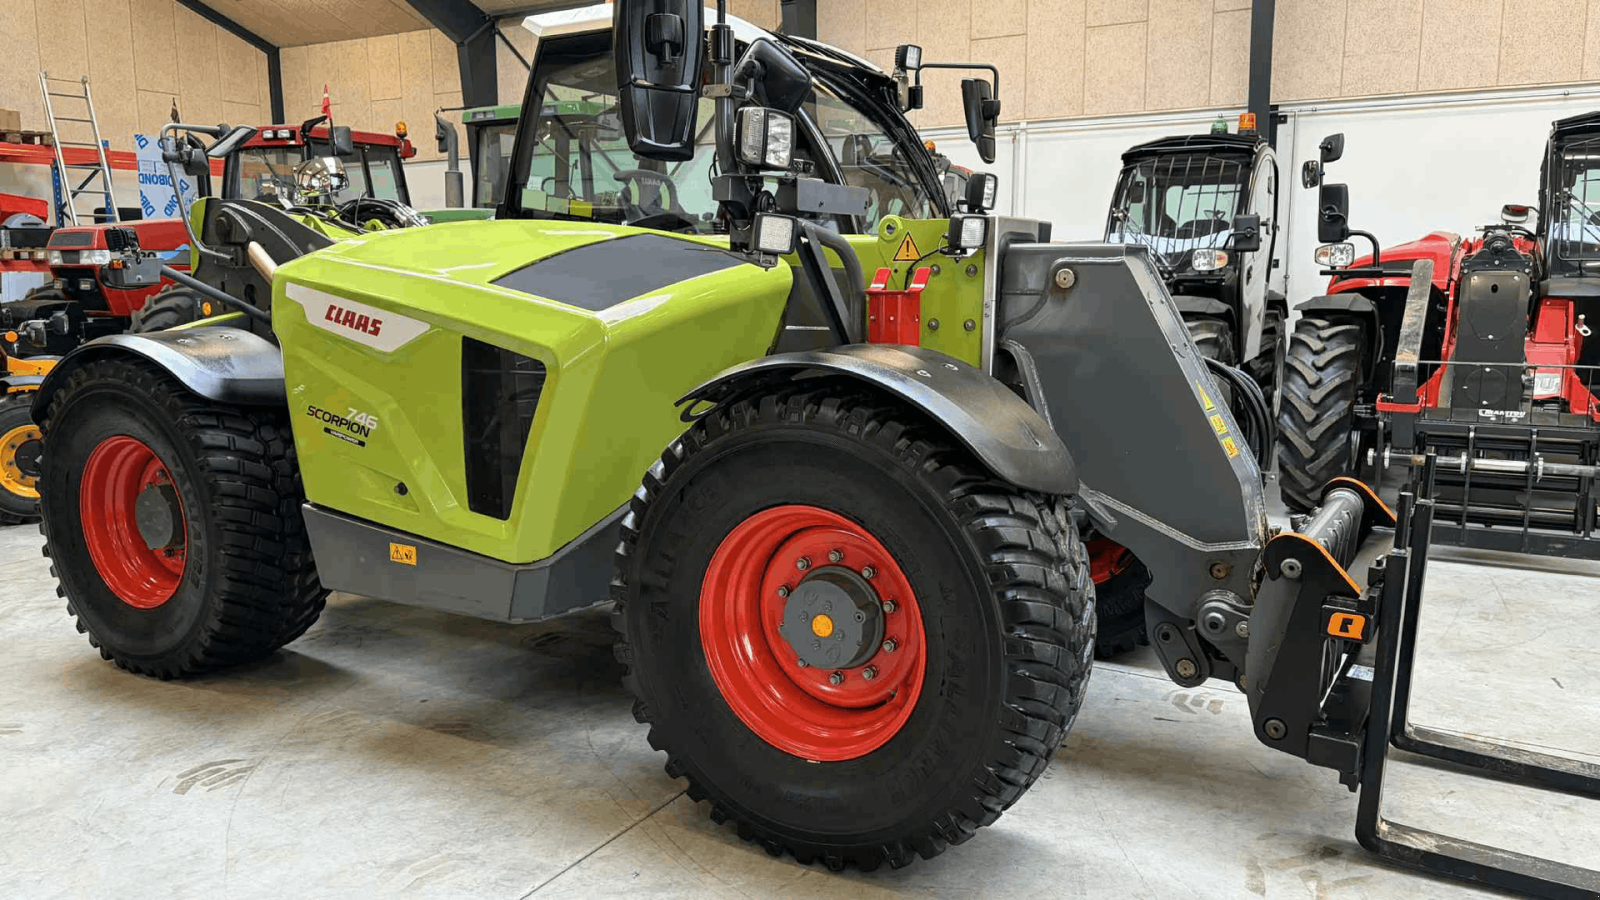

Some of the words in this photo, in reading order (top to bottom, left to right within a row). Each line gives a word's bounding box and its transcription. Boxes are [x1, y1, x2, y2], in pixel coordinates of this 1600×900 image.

[324, 304, 383, 337] CLAAS
[306, 405, 371, 438] SCORPION
[346, 407, 379, 430] 746
